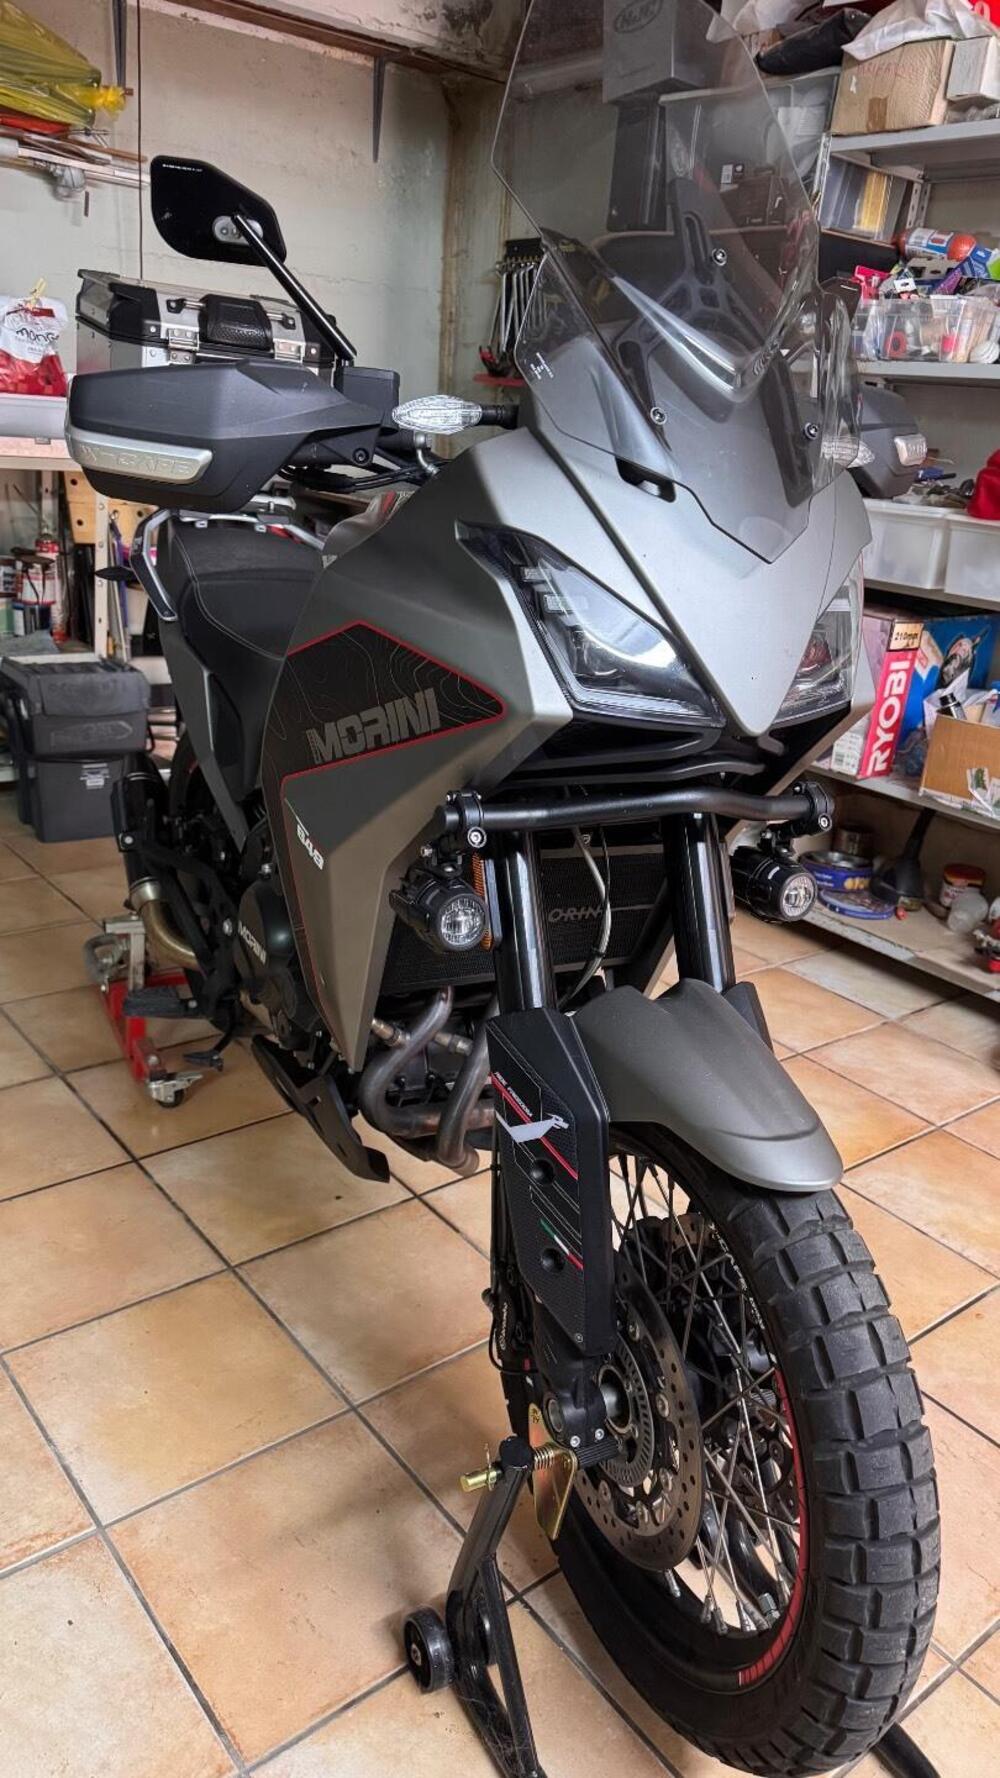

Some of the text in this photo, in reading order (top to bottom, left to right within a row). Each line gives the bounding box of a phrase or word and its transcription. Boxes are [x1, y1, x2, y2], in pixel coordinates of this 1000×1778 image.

[305, 688, 440, 764] MORINI
[866, 659, 911, 776] RYOBI
[297, 824, 324, 870] 649
